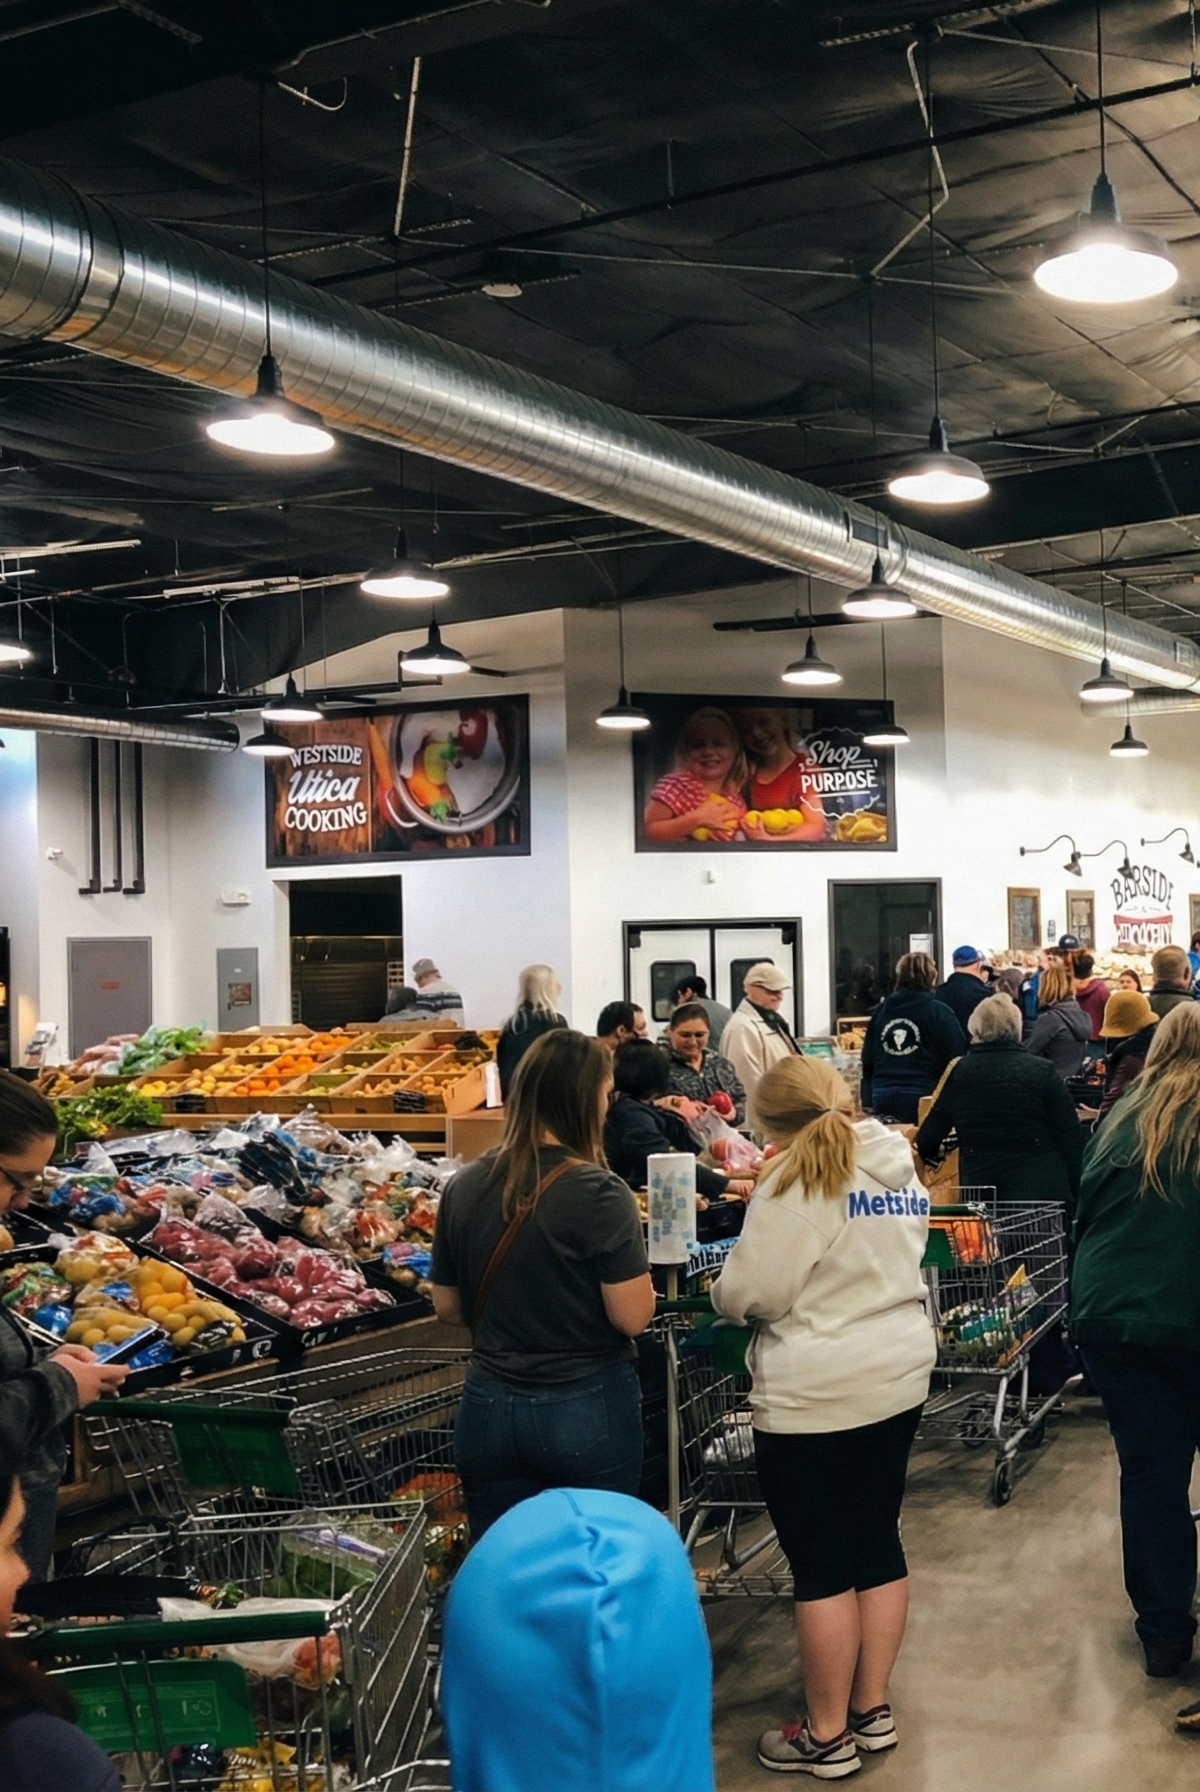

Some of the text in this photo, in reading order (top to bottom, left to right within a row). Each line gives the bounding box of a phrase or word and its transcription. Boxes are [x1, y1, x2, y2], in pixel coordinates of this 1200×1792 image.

[289, 744, 363, 768] WESTSIDE
[805, 740, 861, 769] Shop
[287, 769, 360, 804] Utica
[802, 770, 878, 793] PURPOSE
[285, 802, 367, 831] COOKING
[848, 1187, 929, 1219] Metside
